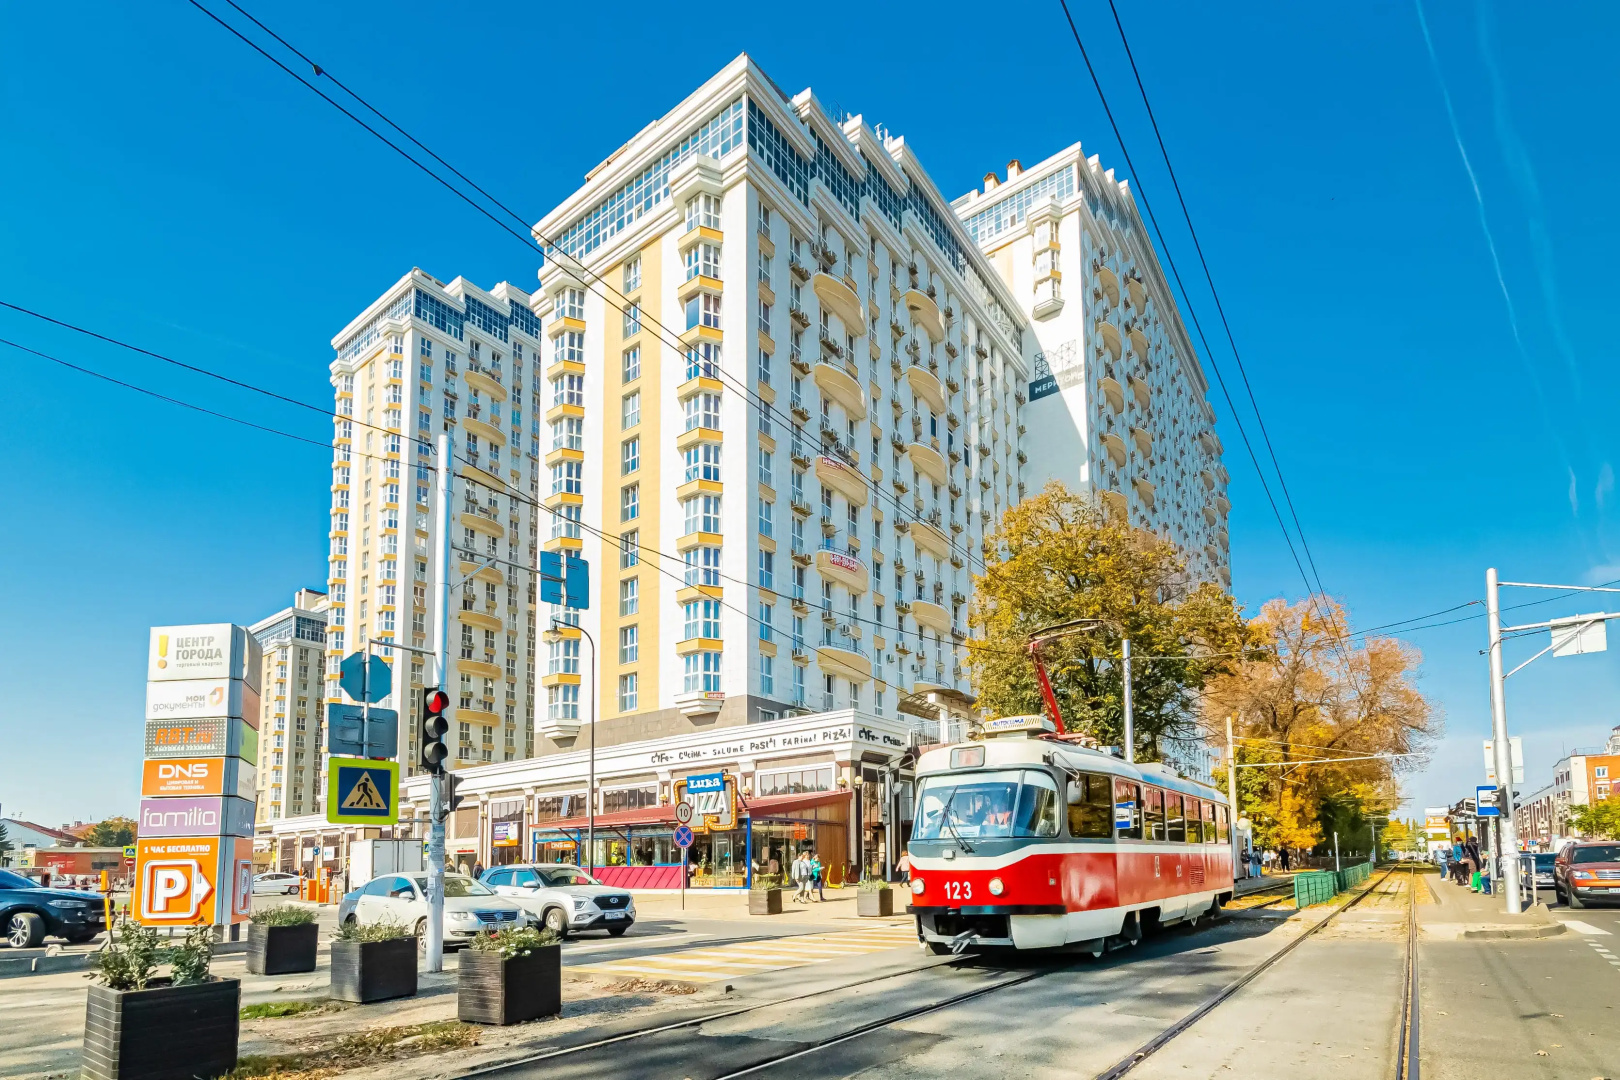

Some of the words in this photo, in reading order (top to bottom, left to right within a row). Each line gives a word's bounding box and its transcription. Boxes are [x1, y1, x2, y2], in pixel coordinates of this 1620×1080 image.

[176, 636, 215, 648] ЦЕНТР
[175, 648, 223, 661] ГОРОДА
[152, 701, 206, 713] документы
[155, 727, 212, 745] RBT.ru
[158, 763, 209, 779] DNS
[689, 778, 721, 789] Luka
[684, 791, 728, 815] PIZZA
[143, 806, 217, 828] familia
[679, 808, 689, 818] 10
[144, 845, 149, 854] 1
[166, 844, 211, 853] БЕСПЛАТНО
[944, 881, 972, 899] 123
